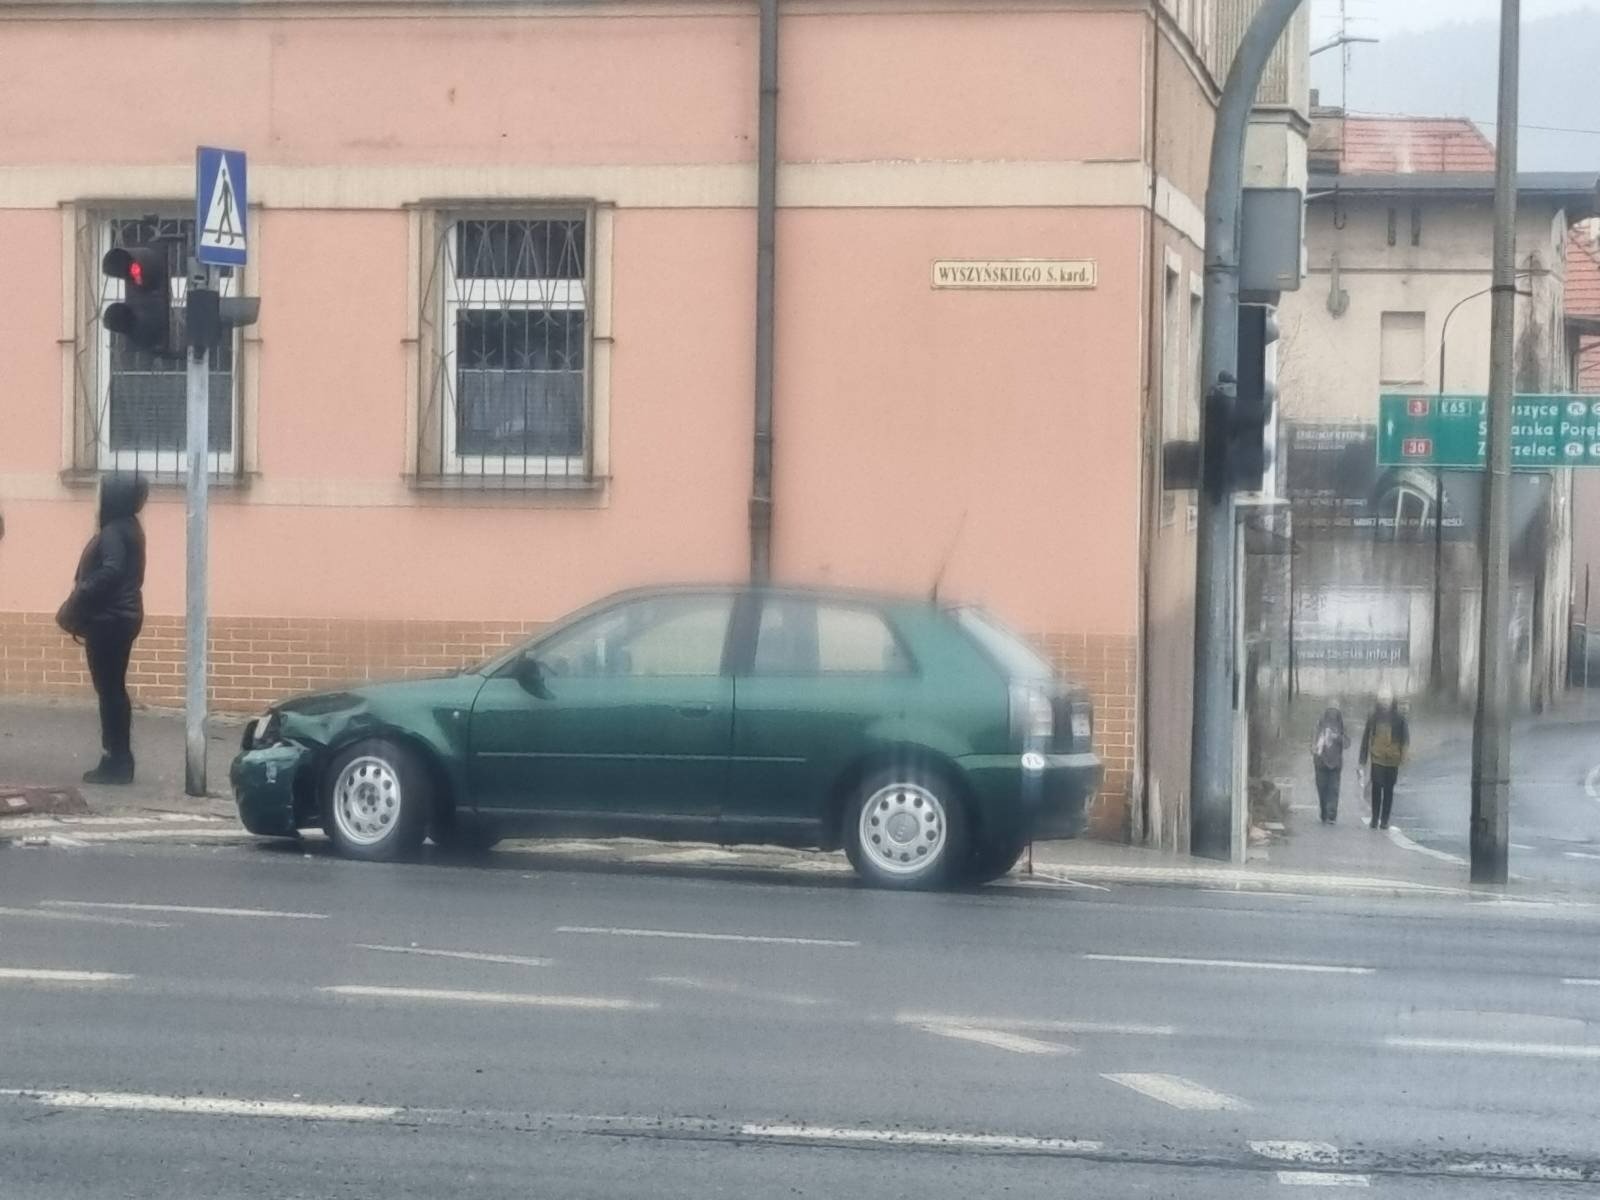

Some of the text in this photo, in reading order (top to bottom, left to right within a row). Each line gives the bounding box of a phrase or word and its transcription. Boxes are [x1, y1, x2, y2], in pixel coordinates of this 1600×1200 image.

[939, 263, 1090, 282] WYSZYŃSKIEGO S. kard.
[1414, 401, 1422, 413] 3
[1441, 401, 1465, 413] E65
[1478, 421, 1554, 436] Sarska
[1408, 441, 1425, 454] 30
